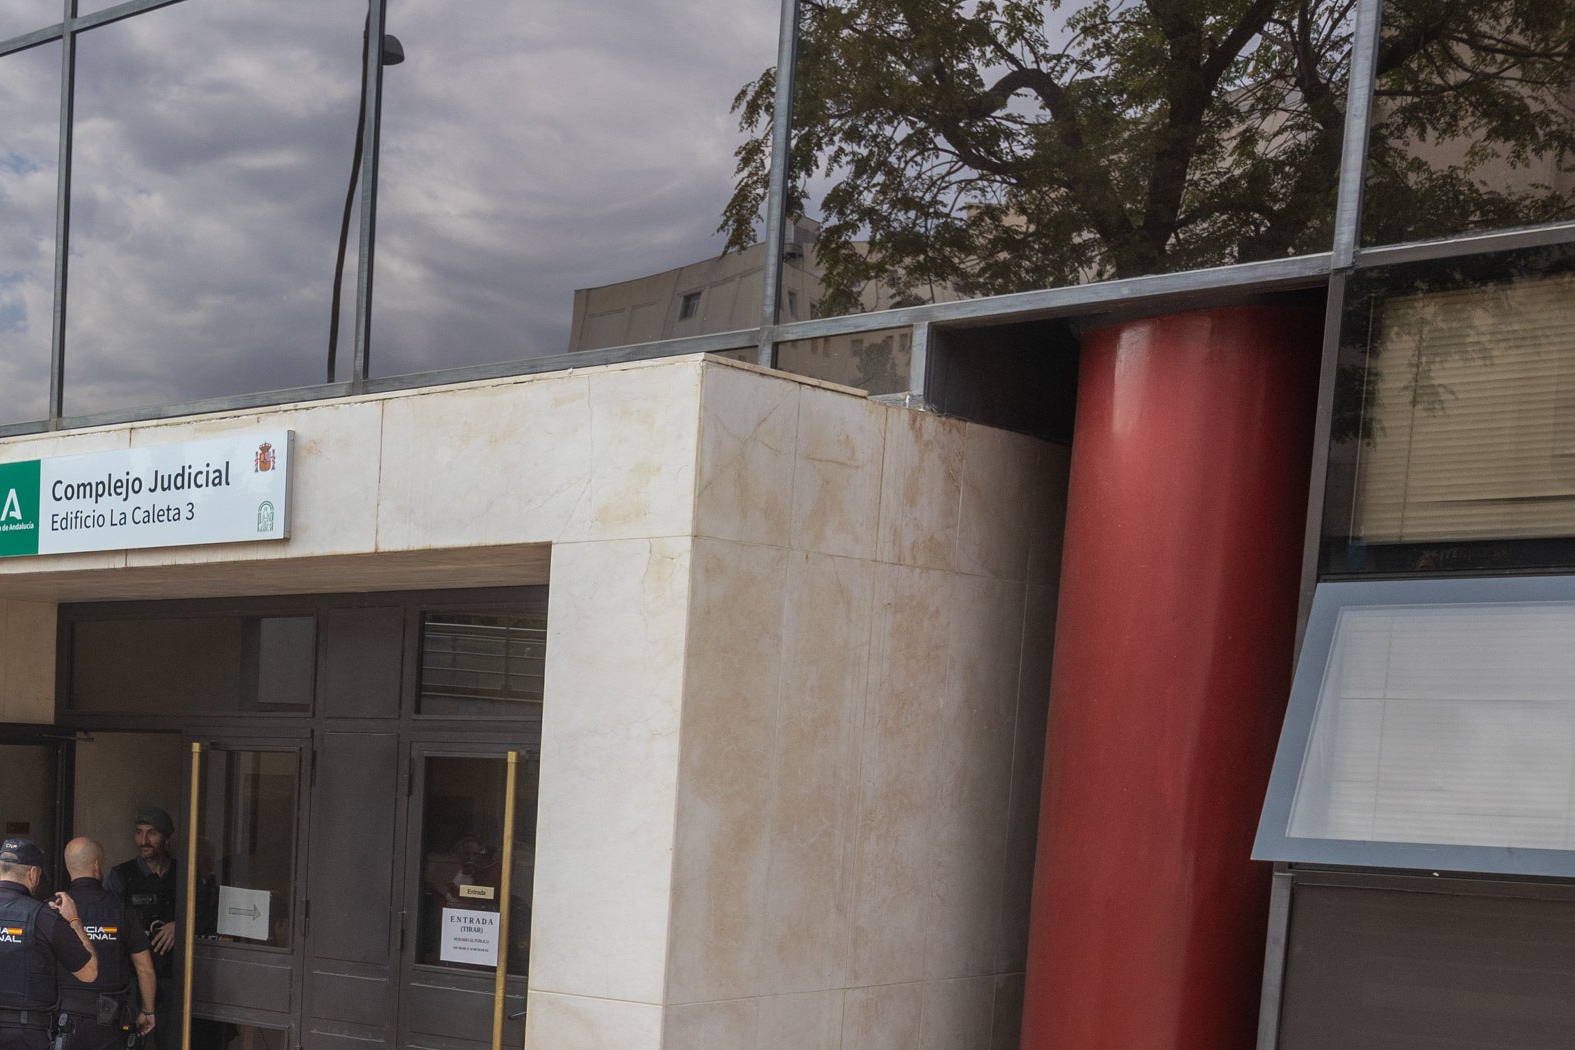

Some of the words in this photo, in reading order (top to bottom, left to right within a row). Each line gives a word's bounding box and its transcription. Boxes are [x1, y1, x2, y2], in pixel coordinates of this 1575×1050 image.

[52, 471, 143, 504] Complejo
[148, 461, 230, 493] Judicial
[51, 509, 105, 531] Edificio
[110, 509, 127, 527] La
[132, 504, 181, 525] Caleta
[185, 502, 195, 521] 3
[9, 521, 34, 530] Andalucía
[467, 888, 487, 896] Entrada
[450, 915, 494, 926] ENTRADA
[460, 925, 484, 934] (TIRAR)
